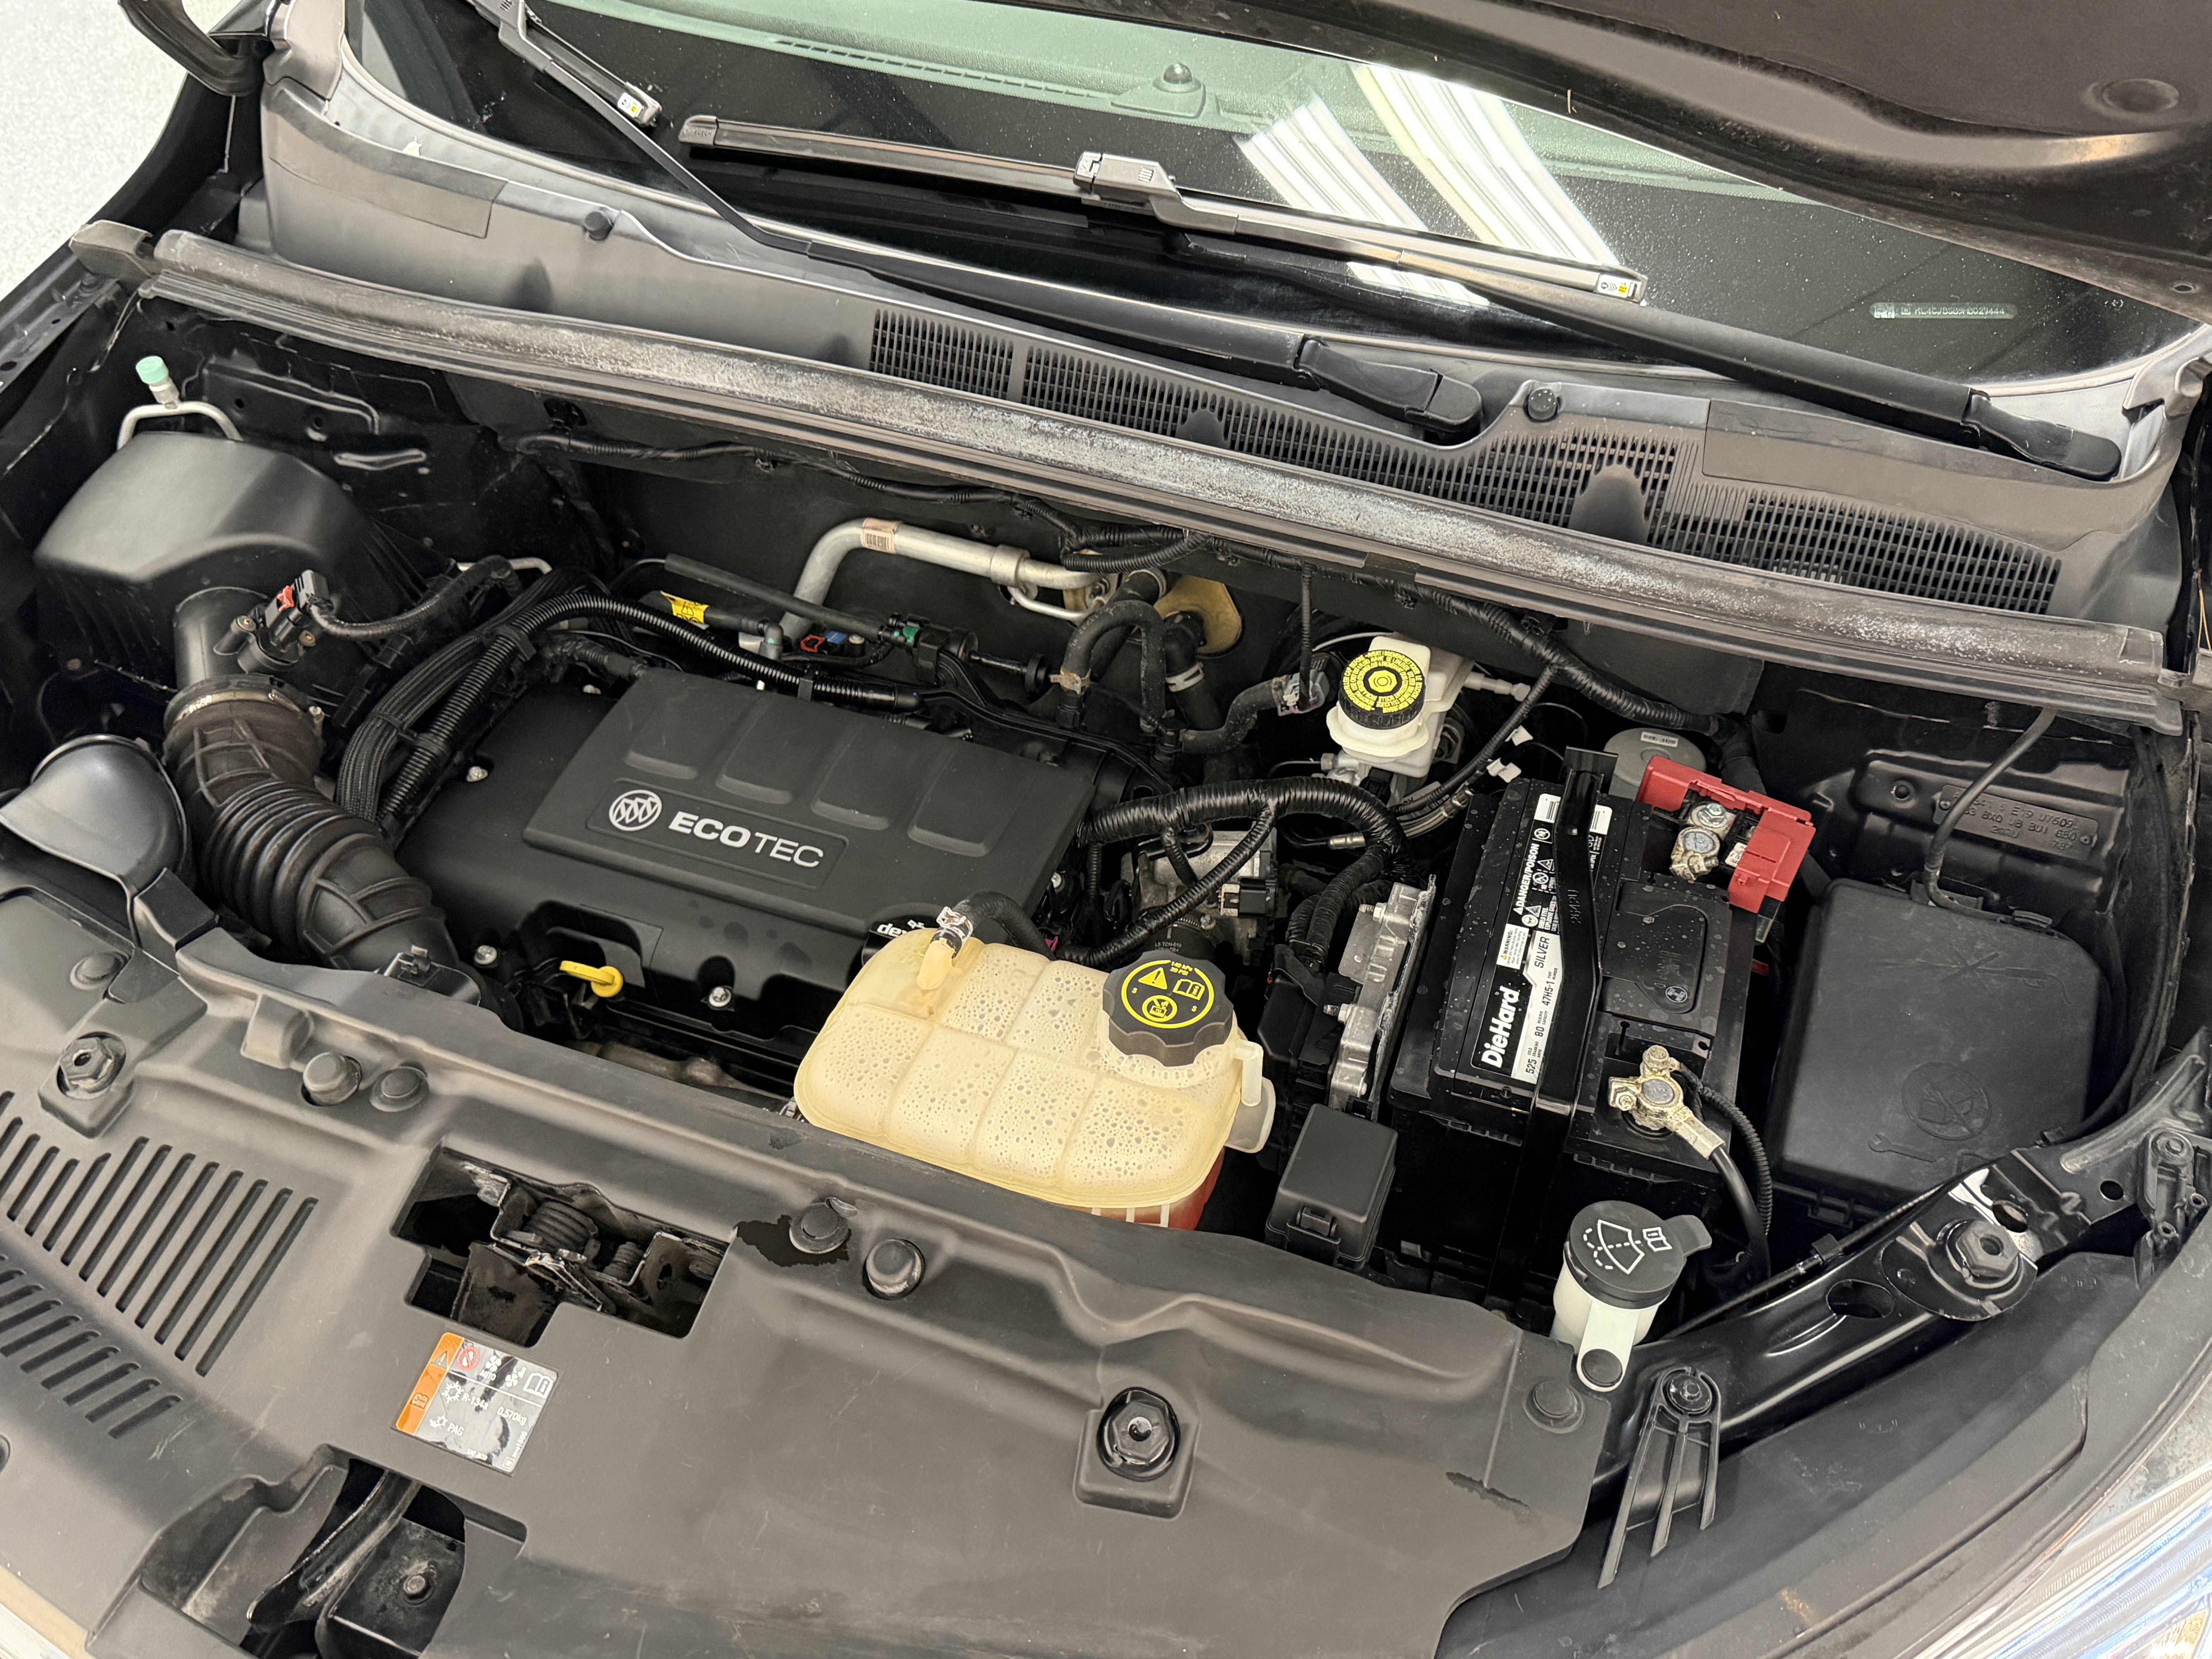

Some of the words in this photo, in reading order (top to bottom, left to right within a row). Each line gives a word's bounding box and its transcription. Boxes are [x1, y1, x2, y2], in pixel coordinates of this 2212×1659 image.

[668, 811, 824, 868] ECOTEC
[1516, 843, 1540, 908] DANGER/POISON
[1534, 936, 1551, 969] SILVER
[1481, 985, 1520, 1069] DieHard
[1534, 1025, 1545, 1037] 80
[1525, 1058, 1537, 1074] 525
[479, 1370, 497, 1381] AUTO
[461, 1393, 489, 1410] R-134a
[497, 1406, 527, 1426] 0.570kg
[447, 1423, 465, 1436] PAG
